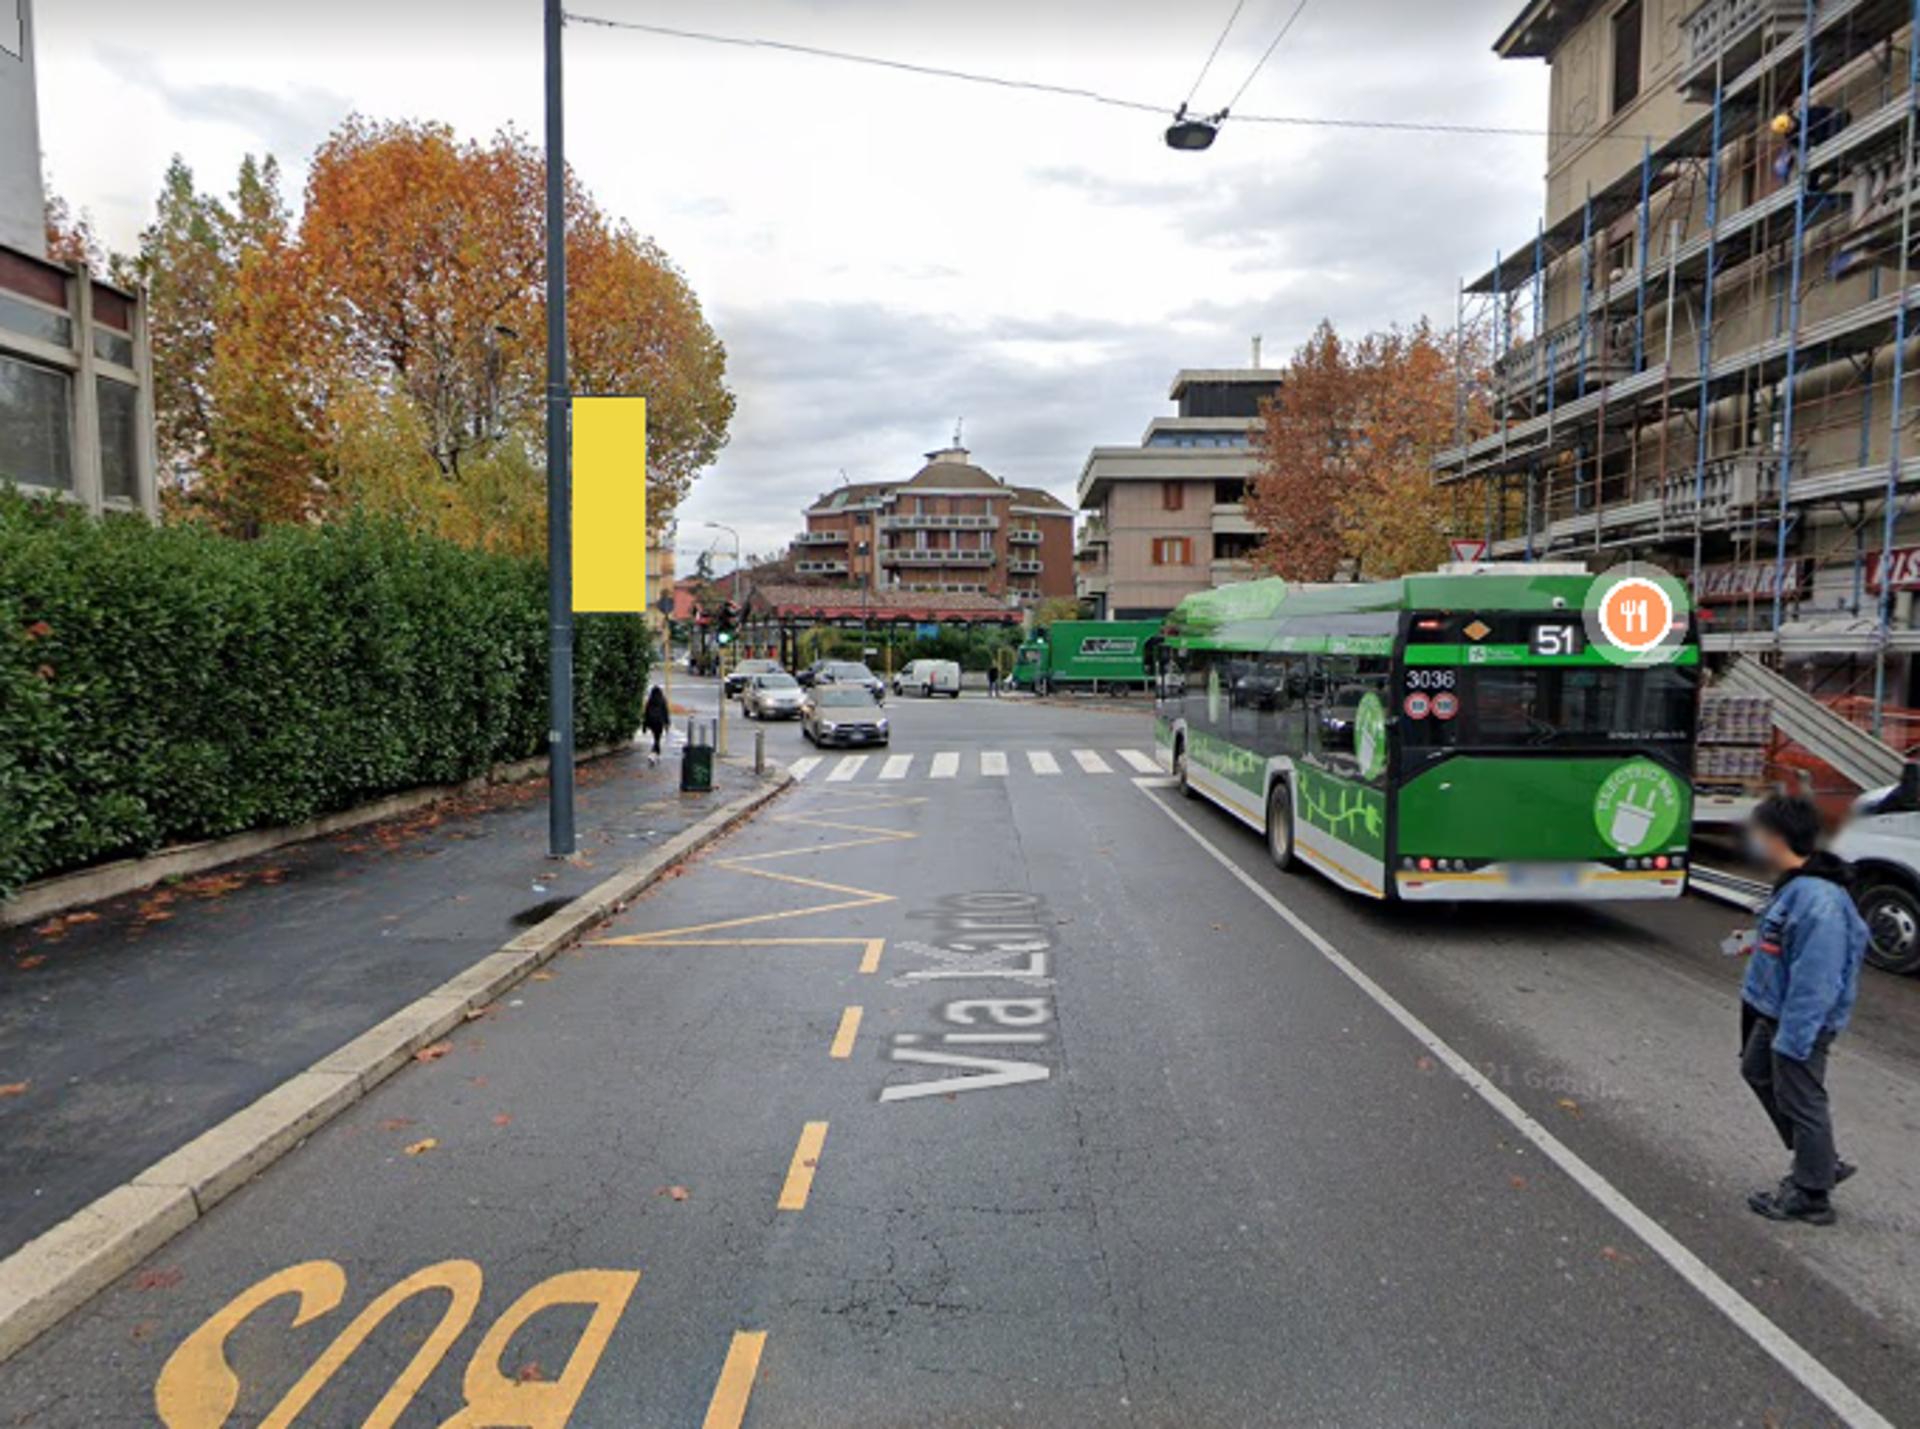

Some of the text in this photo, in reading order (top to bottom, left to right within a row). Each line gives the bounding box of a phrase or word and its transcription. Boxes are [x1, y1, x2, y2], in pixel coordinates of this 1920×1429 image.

[1538, 625, 1573, 655] 51
[1406, 669, 1456, 689] 3036
[154, 1258, 642, 1429] BUS
